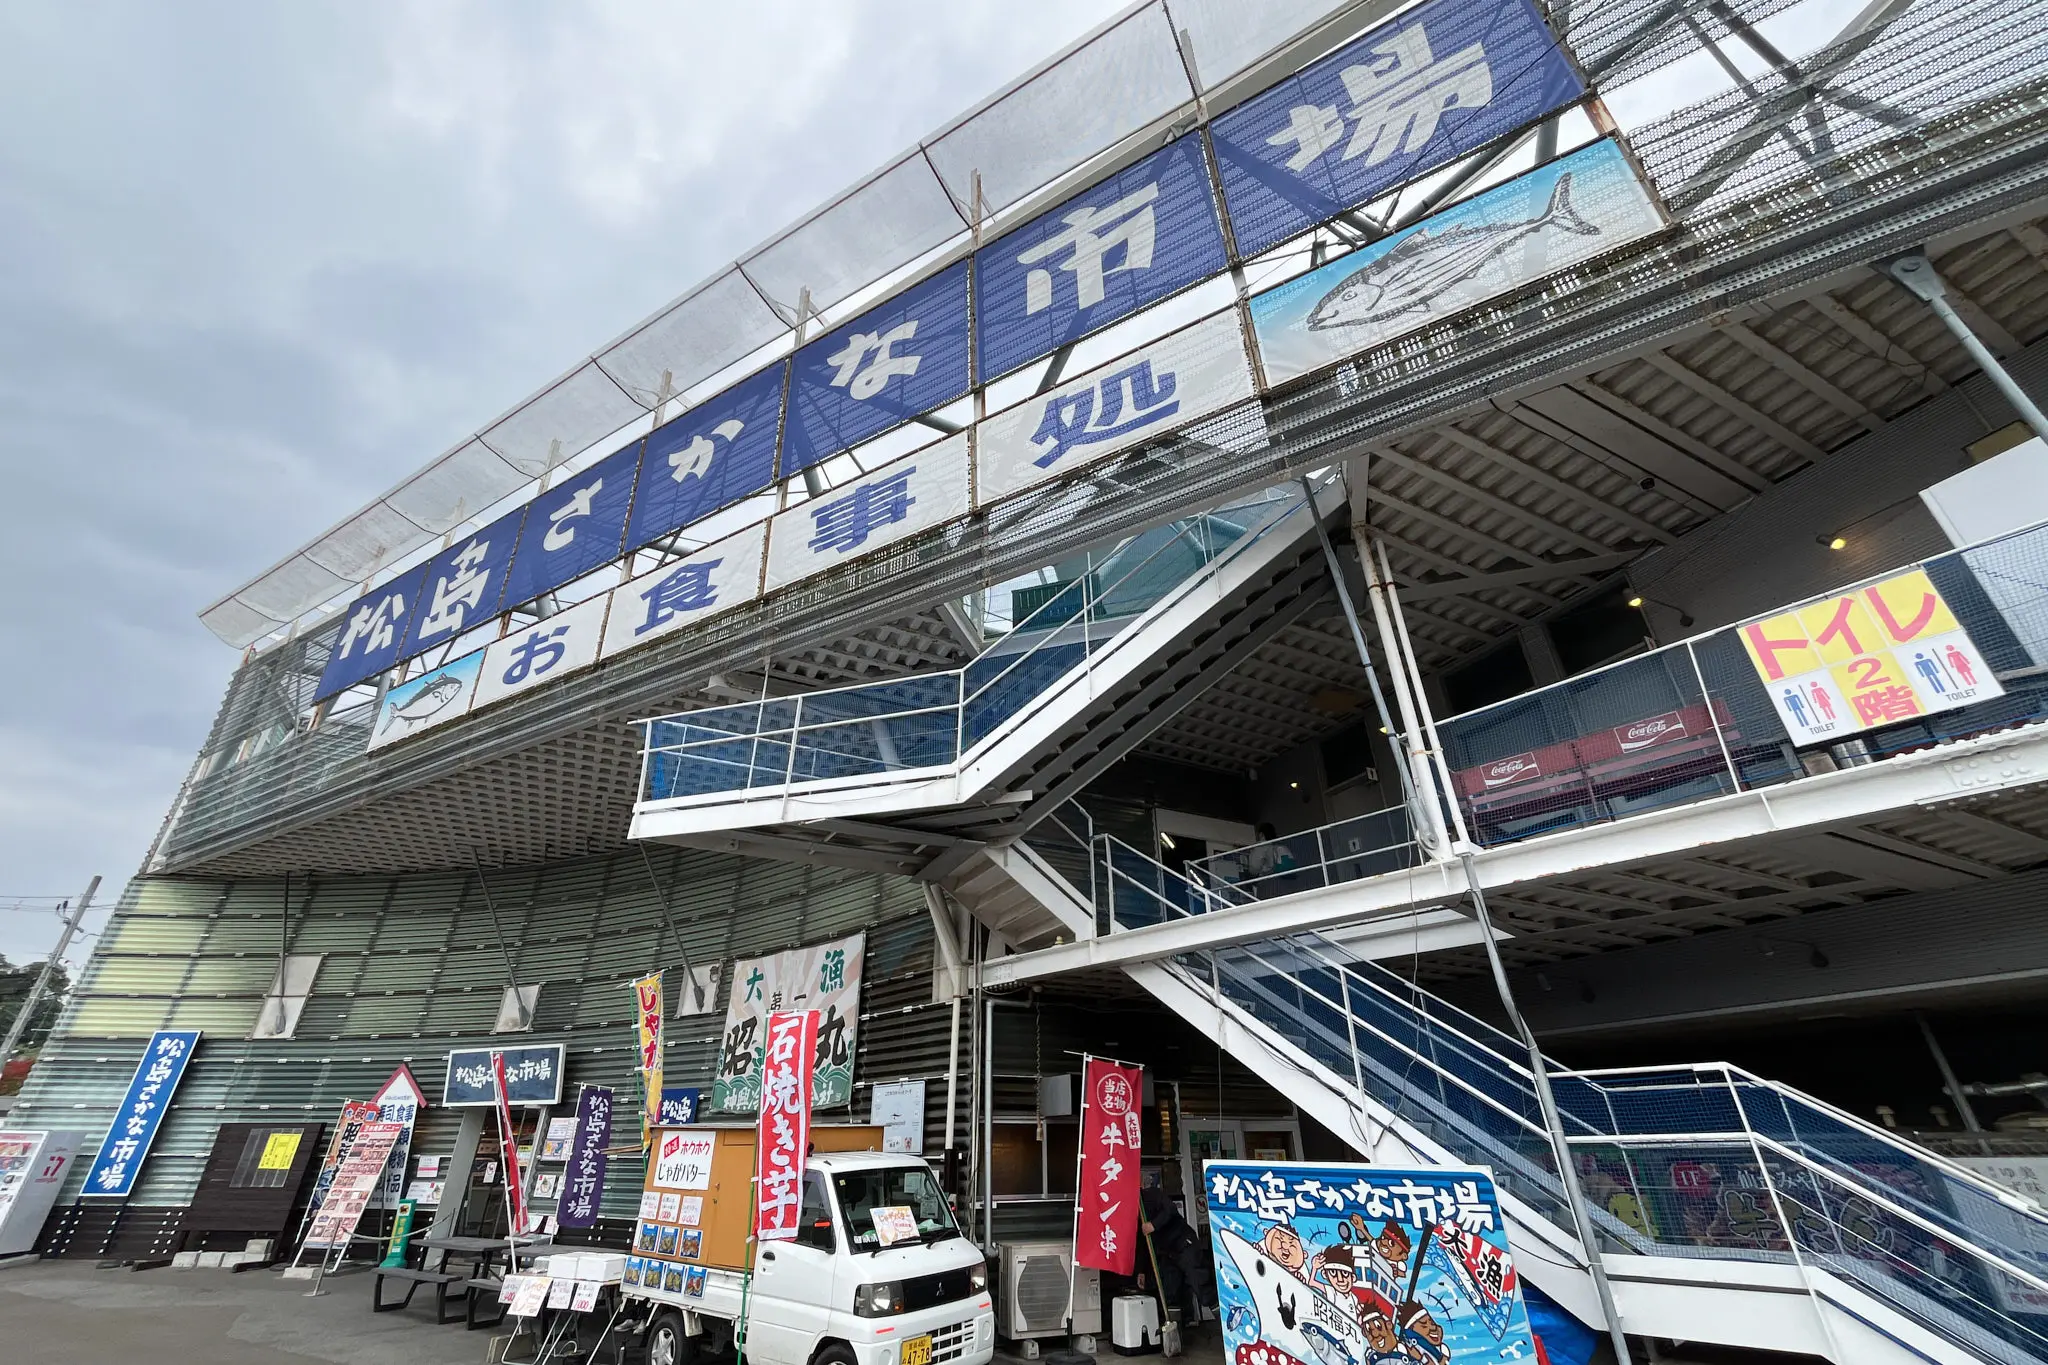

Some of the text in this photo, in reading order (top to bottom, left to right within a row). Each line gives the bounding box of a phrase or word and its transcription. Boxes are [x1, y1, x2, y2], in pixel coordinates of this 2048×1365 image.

[338, 22, 1492, 660] 松島さかな市場
[502, 358, 1181, 686] お食事処
[1745, 585, 1937, 681] トイレ
[1847, 656, 1921, 728] 2階
[1945, 687, 1977, 702] TOILET
[1628, 720, 1667, 739] Coca-Cola
[1808, 721, 1836, 736] TOILET
[1491, 759, 1523, 776] Coca-Cola
[720, 1004, 849, 1077] 昭丸
[456, 1058, 552, 1089] 松島さな市場
[1103, 1078, 1126, 1096] 当店
[1103, 1094, 1126, 1111] 名物
[99, 1036, 187, 1191] 松島さかな市場
[762, 1016, 800, 1230] 石焼き芋
[567, 1095, 609, 1219] 松島さかな市場
[658, 1162, 707, 1183] じゃがバター
[680, 1140, 711, 1156] ホクホク
[1099, 1121, 1125, 1260] 牛タン串
[1212, 1170, 1494, 1234] 松島さかな市場
[1440, 1228, 1504, 1302] 大漁
[1312, 1295, 1362, 1345] 昭福丸
